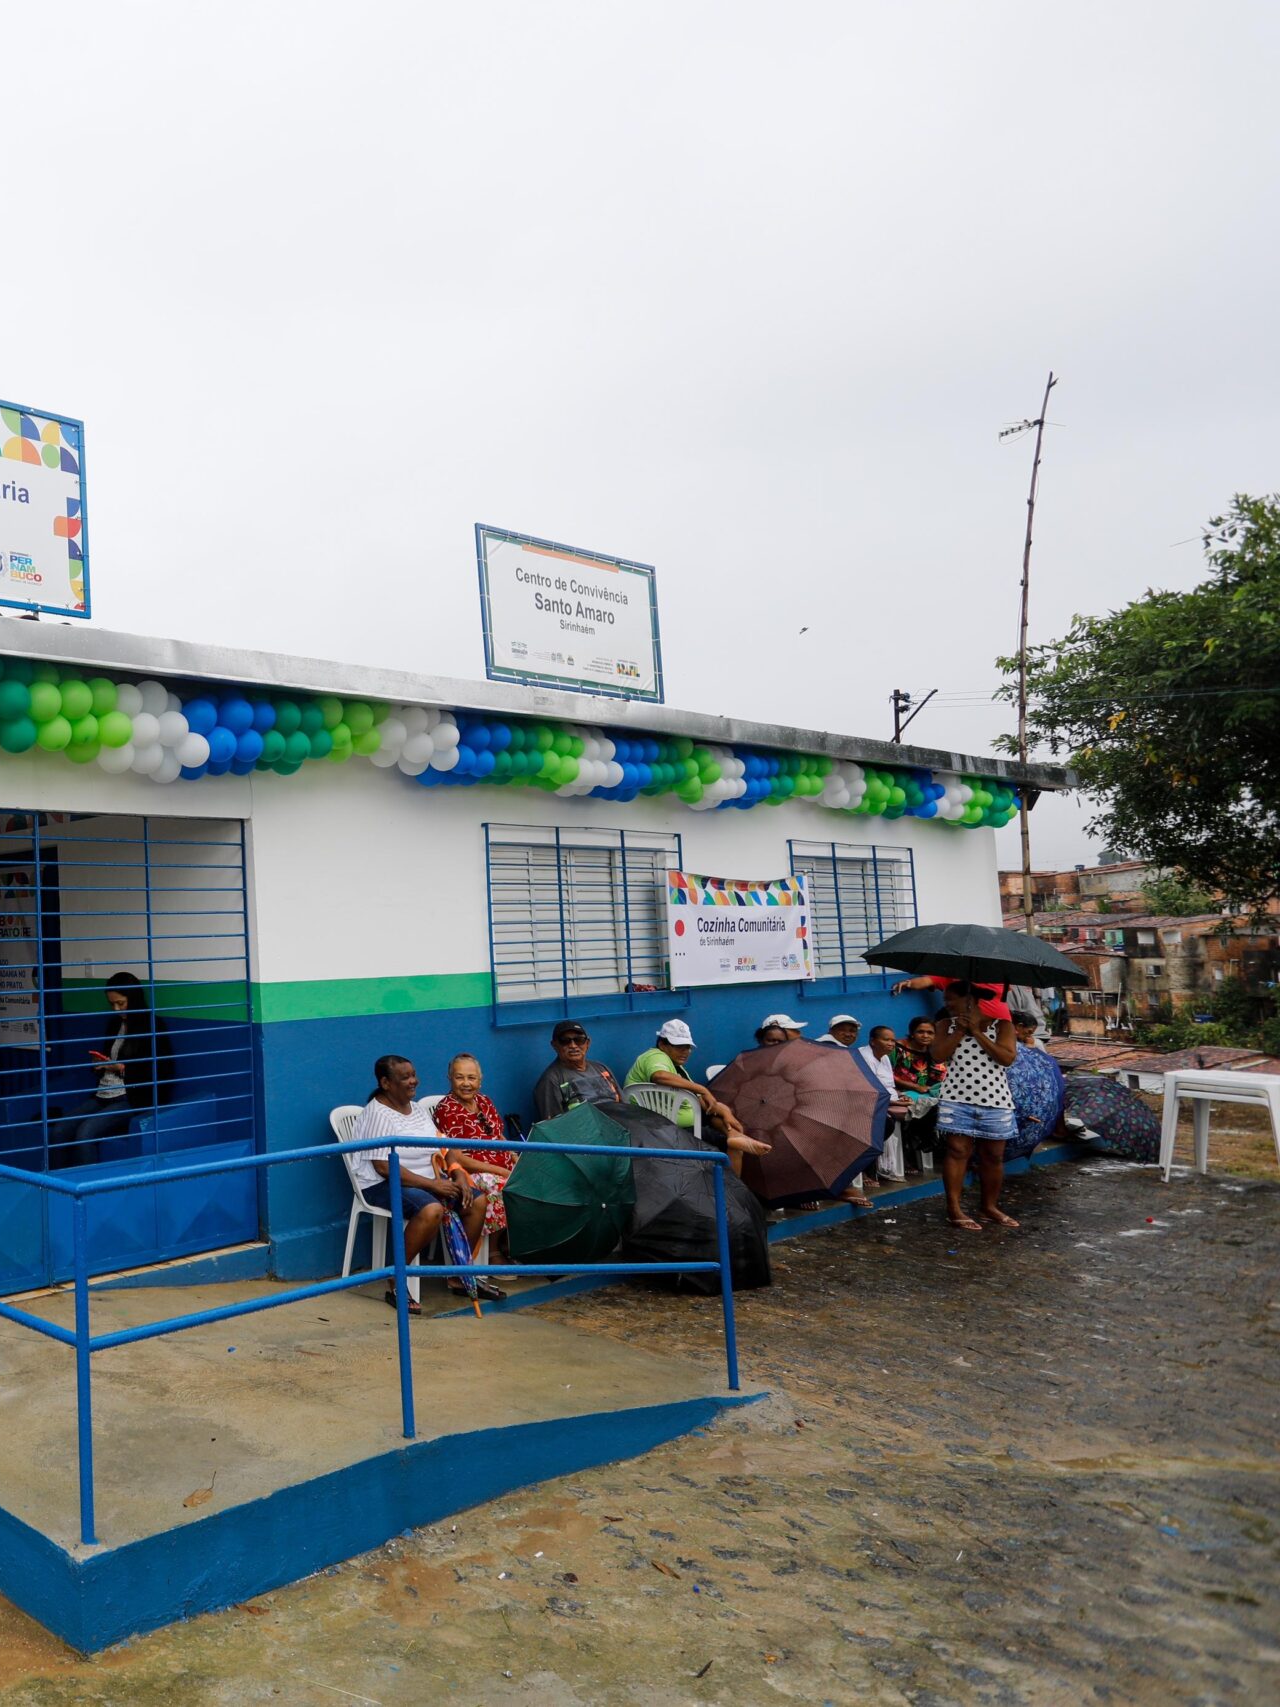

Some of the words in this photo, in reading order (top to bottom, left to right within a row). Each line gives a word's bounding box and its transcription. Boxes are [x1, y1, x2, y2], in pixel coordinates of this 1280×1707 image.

[515, 567, 551, 588] Centro
[555, 576, 567, 592] de
[570, 579, 628, 605] Convivência
[534, 592, 572, 616] Santo
[575, 601, 615, 624] Amaro
[559, 619, 595, 635] Sirinhaém
[697, 916, 736, 933] Cozinha
[738, 916, 786, 933] Comunitária
[699, 937, 706, 946] de
[707, 937, 735, 946] Sirinhaém
